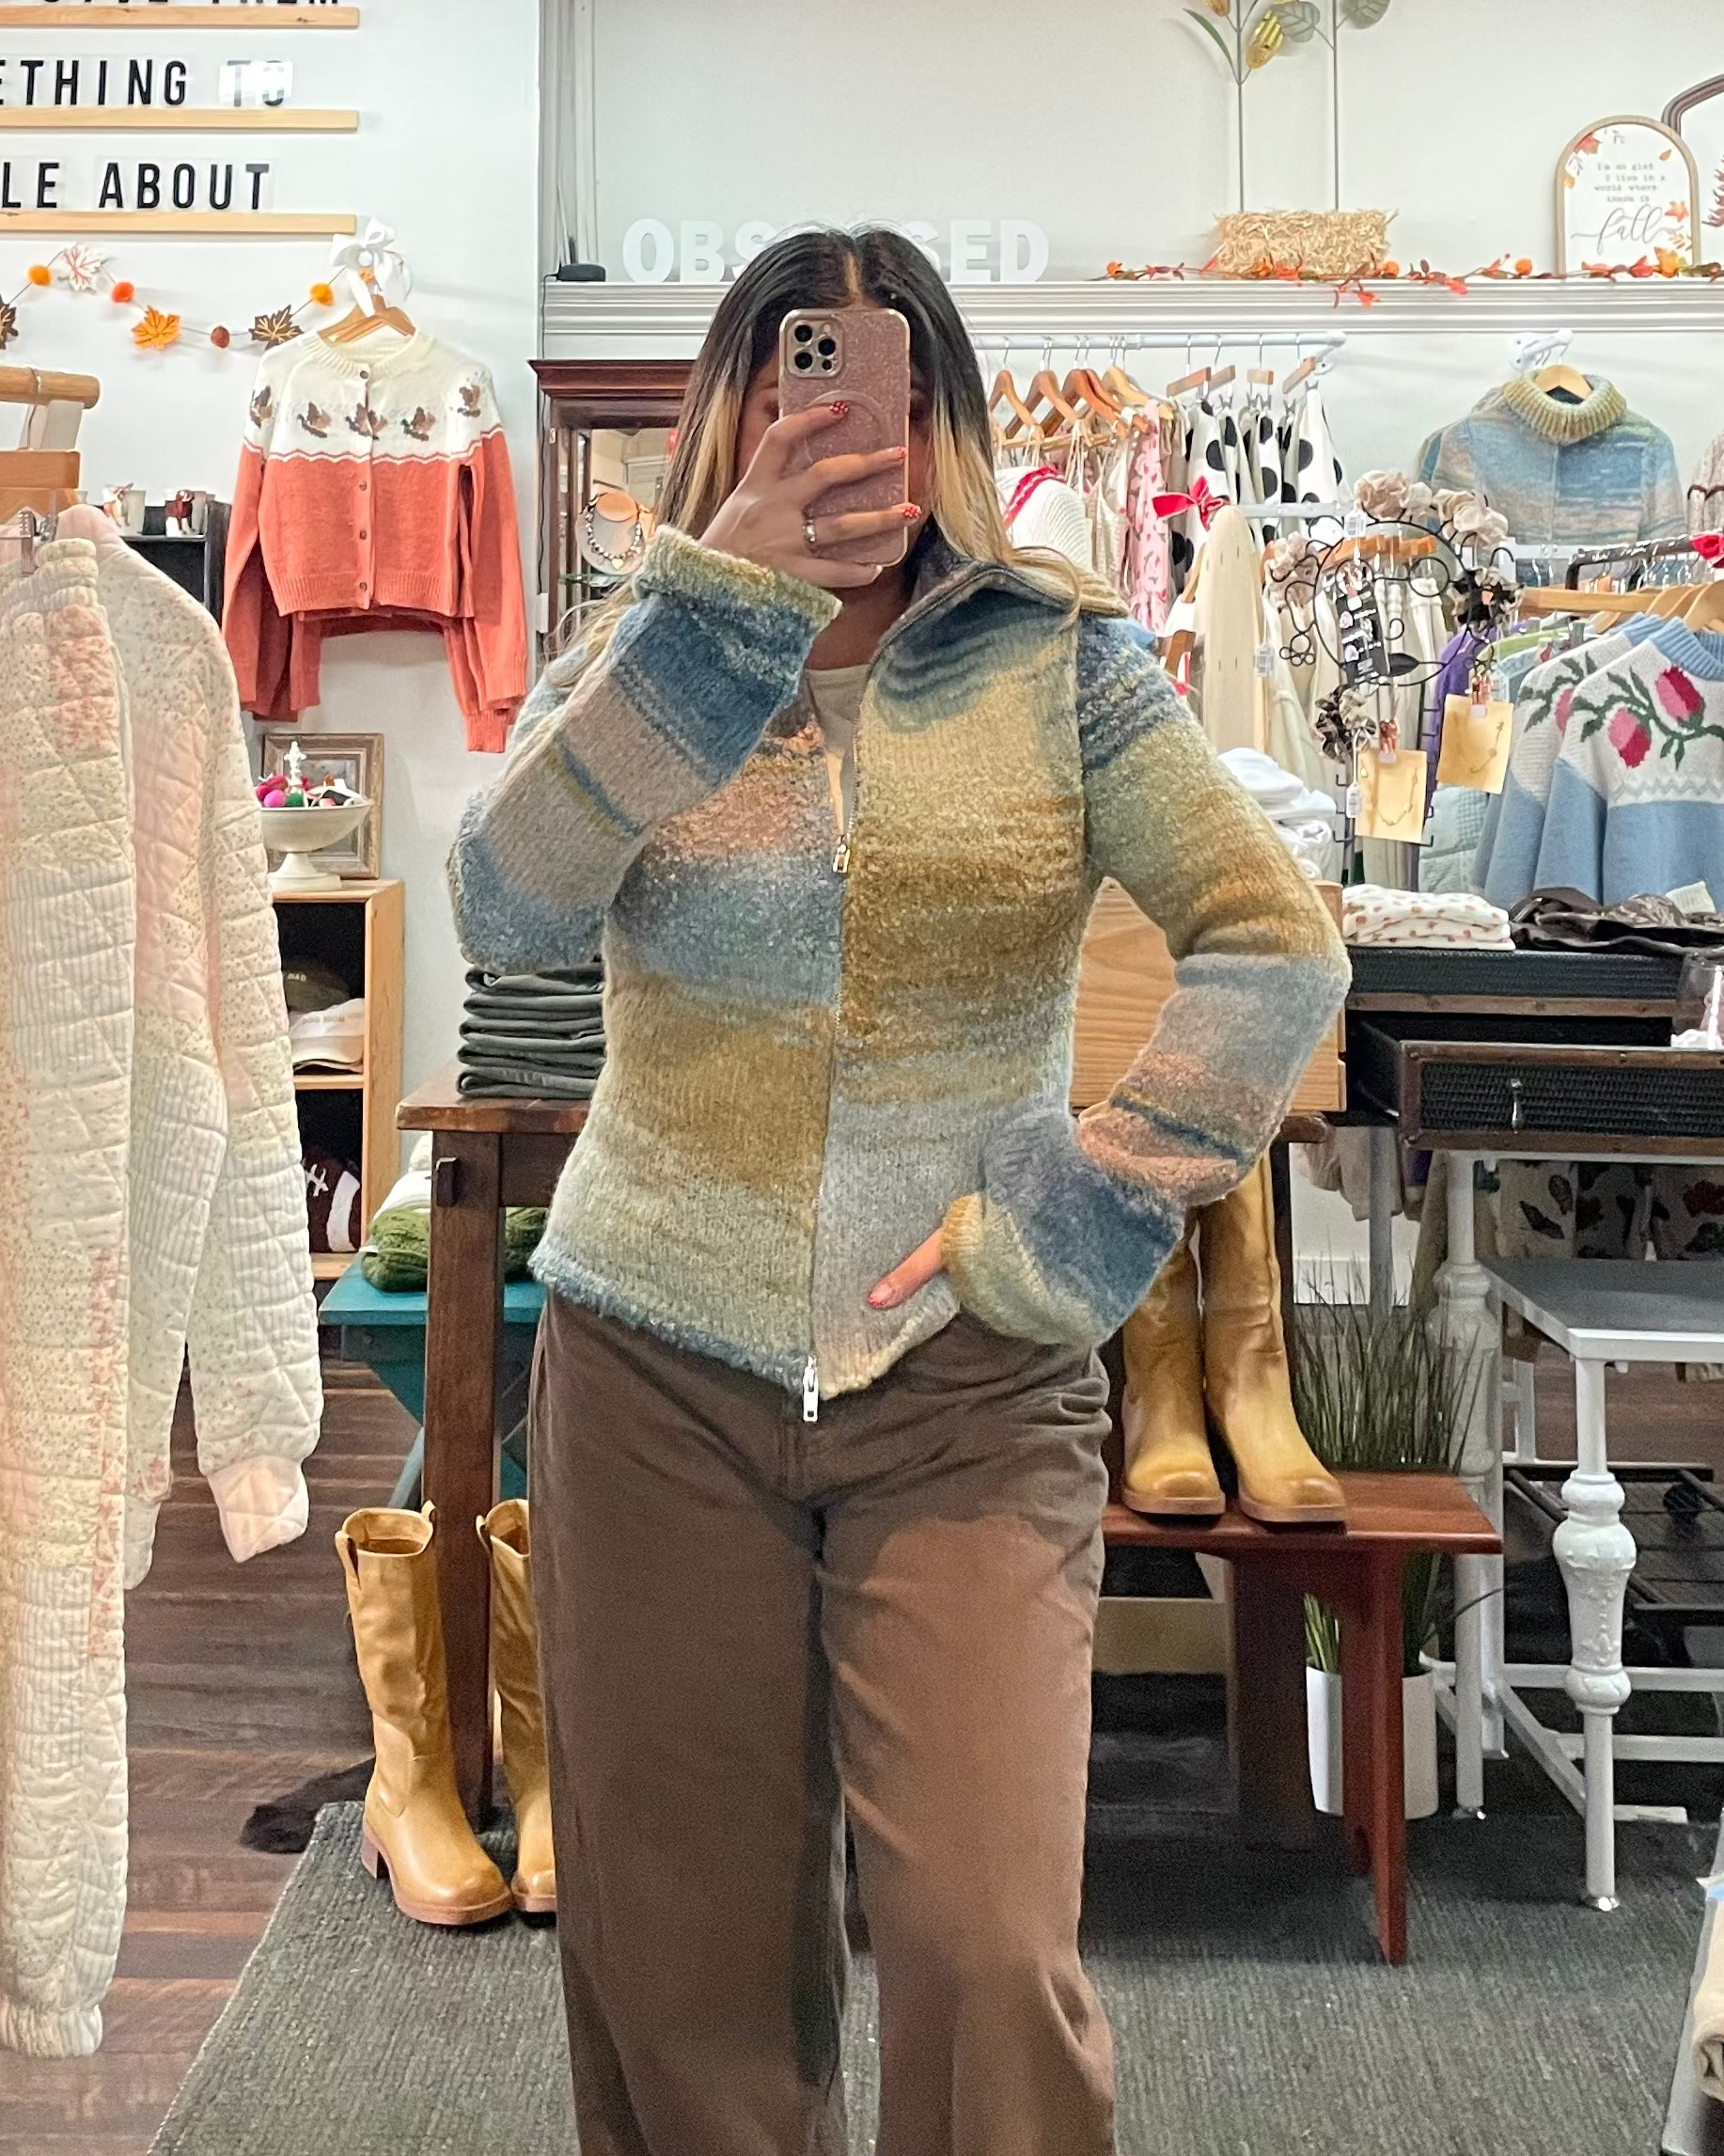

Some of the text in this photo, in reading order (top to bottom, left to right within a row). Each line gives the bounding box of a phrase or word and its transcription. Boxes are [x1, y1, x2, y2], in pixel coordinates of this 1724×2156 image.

[0, 59, 187, 106] THING
[1, 162, 270, 211] LE ABOUT
[1616, 174, 1638, 182] live
[1643, 174, 1655, 182] in
[1632, 163, 1653, 171] glad
[1575, 204, 1679, 256] fall
